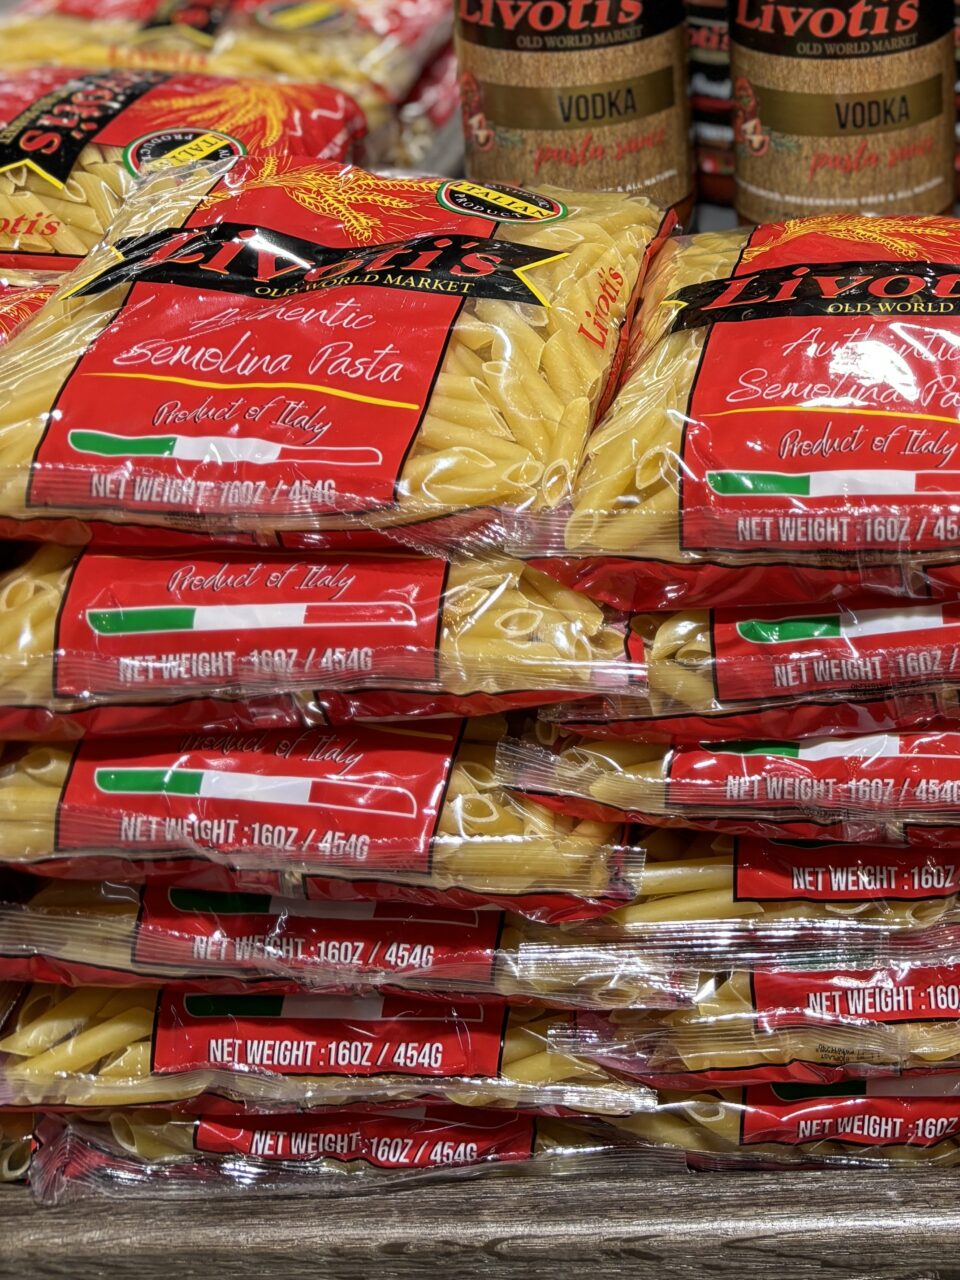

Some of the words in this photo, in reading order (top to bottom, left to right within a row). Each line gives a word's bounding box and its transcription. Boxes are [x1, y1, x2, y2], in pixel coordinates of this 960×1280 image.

[517, 35, 543, 49] OLD
[544, 33, 592, 48] WORLD
[594, 24, 644, 45] MARKET
[796, 41, 823, 55] OLD
[824, 40, 871, 55] WORLD
[872, 32, 919, 54] MARKET
[558, 87, 638, 124] VODKA
[835, 95, 910, 130] VODKA
[533, 132, 605, 175] pasta
[450, 181, 552, 218] ITALIAN
[454, 193, 522, 218] PRODUCT
[255, 285, 299, 298] OLD
[306, 274, 380, 293] WORLD
[384, 272, 475, 295] MARKET
[578, 267, 624, 350] Livoti's
[828, 301, 872, 315] OLD
[876, 300, 954, 315] WORLD
[113, 331, 291, 376] Semolina
[308, 340, 405, 384] Pasta
[726, 367, 901, 407] Semolina
[153, 395, 247, 427] Product
[247, 395, 277, 421] of
[271, 399, 333, 445] Italy
[779, 422, 865, 460] Product
[872, 425, 899, 452] of
[894, 427, 960, 460] Italy
[91, 473, 128, 499] NET
[133, 476, 212, 505] WEIGHT
[736, 516, 772, 542] NET
[777, 516, 850, 542] WEIGHT
[915, 516, 928, 542] /
[166, 563, 263, 592] Product
[264, 562, 299, 590] of
[294, 563, 357, 601] Italy
[118, 655, 157, 683] NET
[160, 651, 236, 680] WEIGHT
[303, 647, 317, 672] /
[318, 647, 373, 672] 454G
[773, 662, 809, 688] NET
[813, 656, 882, 682] WEIGHT
[948, 648, 960, 673] /
[275, 731, 309, 758] of
[302, 734, 365, 776] Italy
[766, 777, 838, 801] WEIGHT
[900, 777, 911, 801] /
[120, 816, 161, 841] NET
[164, 818, 239, 846] WEIGHT
[302, 829, 317, 853] /
[318, 830, 371, 860] 454G
[792, 866, 826, 891] NET
[829, 866, 898, 892] WEIGHT
[193, 935, 228, 961] NET
[235, 935, 306, 961] WEIGHT
[368, 940, 381, 964] /
[384, 941, 435, 969] 454G
[808, 991, 842, 1015] NET
[846, 985, 915, 1015] WEIGHT
[209, 1039, 243, 1063] NET
[247, 1039, 317, 1066] WEIGHT
[376, 1042, 390, 1067] /
[392, 1042, 444, 1068] 454G
[799, 1119, 834, 1138] NET
[836, 1114, 905, 1139] WEIGHT
[251, 1129, 290, 1155] NET
[290, 1131, 361, 1155] WEIGHT
[413, 1140, 428, 1163] /
[430, 1140, 478, 1164] 454G
